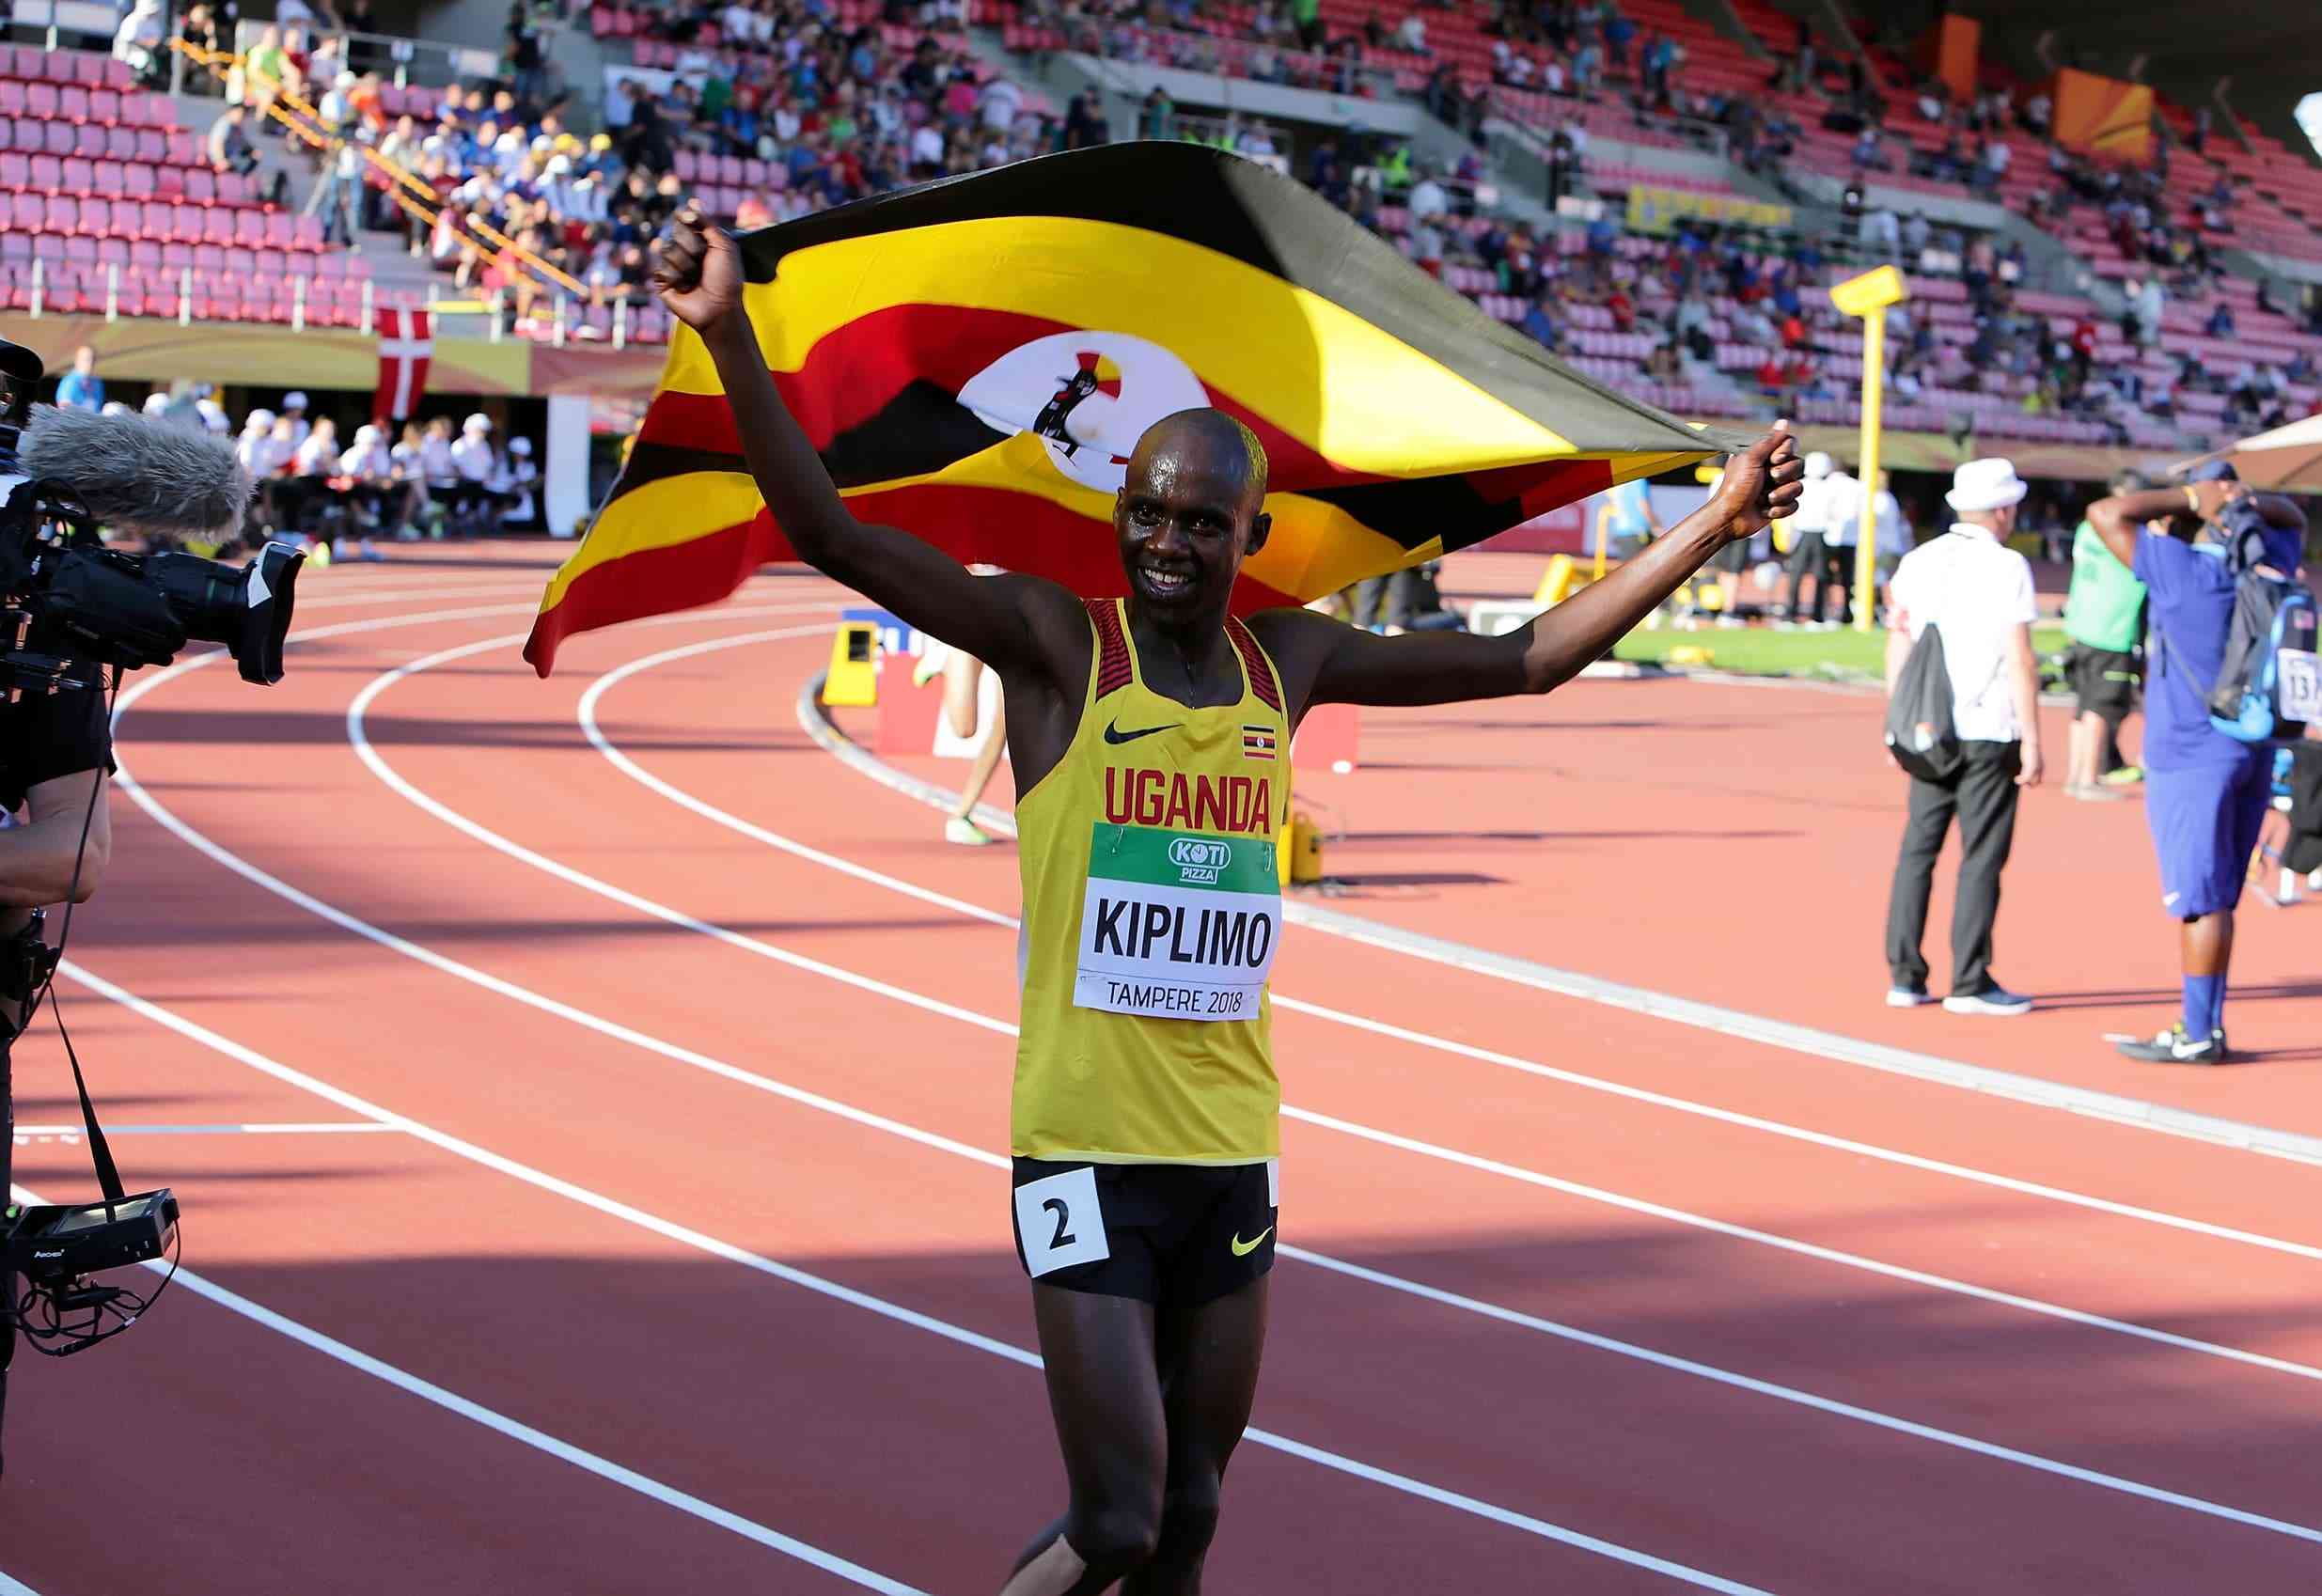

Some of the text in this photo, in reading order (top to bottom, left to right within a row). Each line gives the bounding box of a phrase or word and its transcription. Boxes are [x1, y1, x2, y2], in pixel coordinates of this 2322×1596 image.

[1106, 768, 1271, 834] UGANDA
[1177, 842, 1225, 865] KOTI
[1182, 868, 1214, 880] PIZZA
[1093, 899, 1272, 968] KIPLIMO
[1107, 981, 1243, 1013] TAMPERE 2018
[1042, 1197, 1076, 1250] 2
